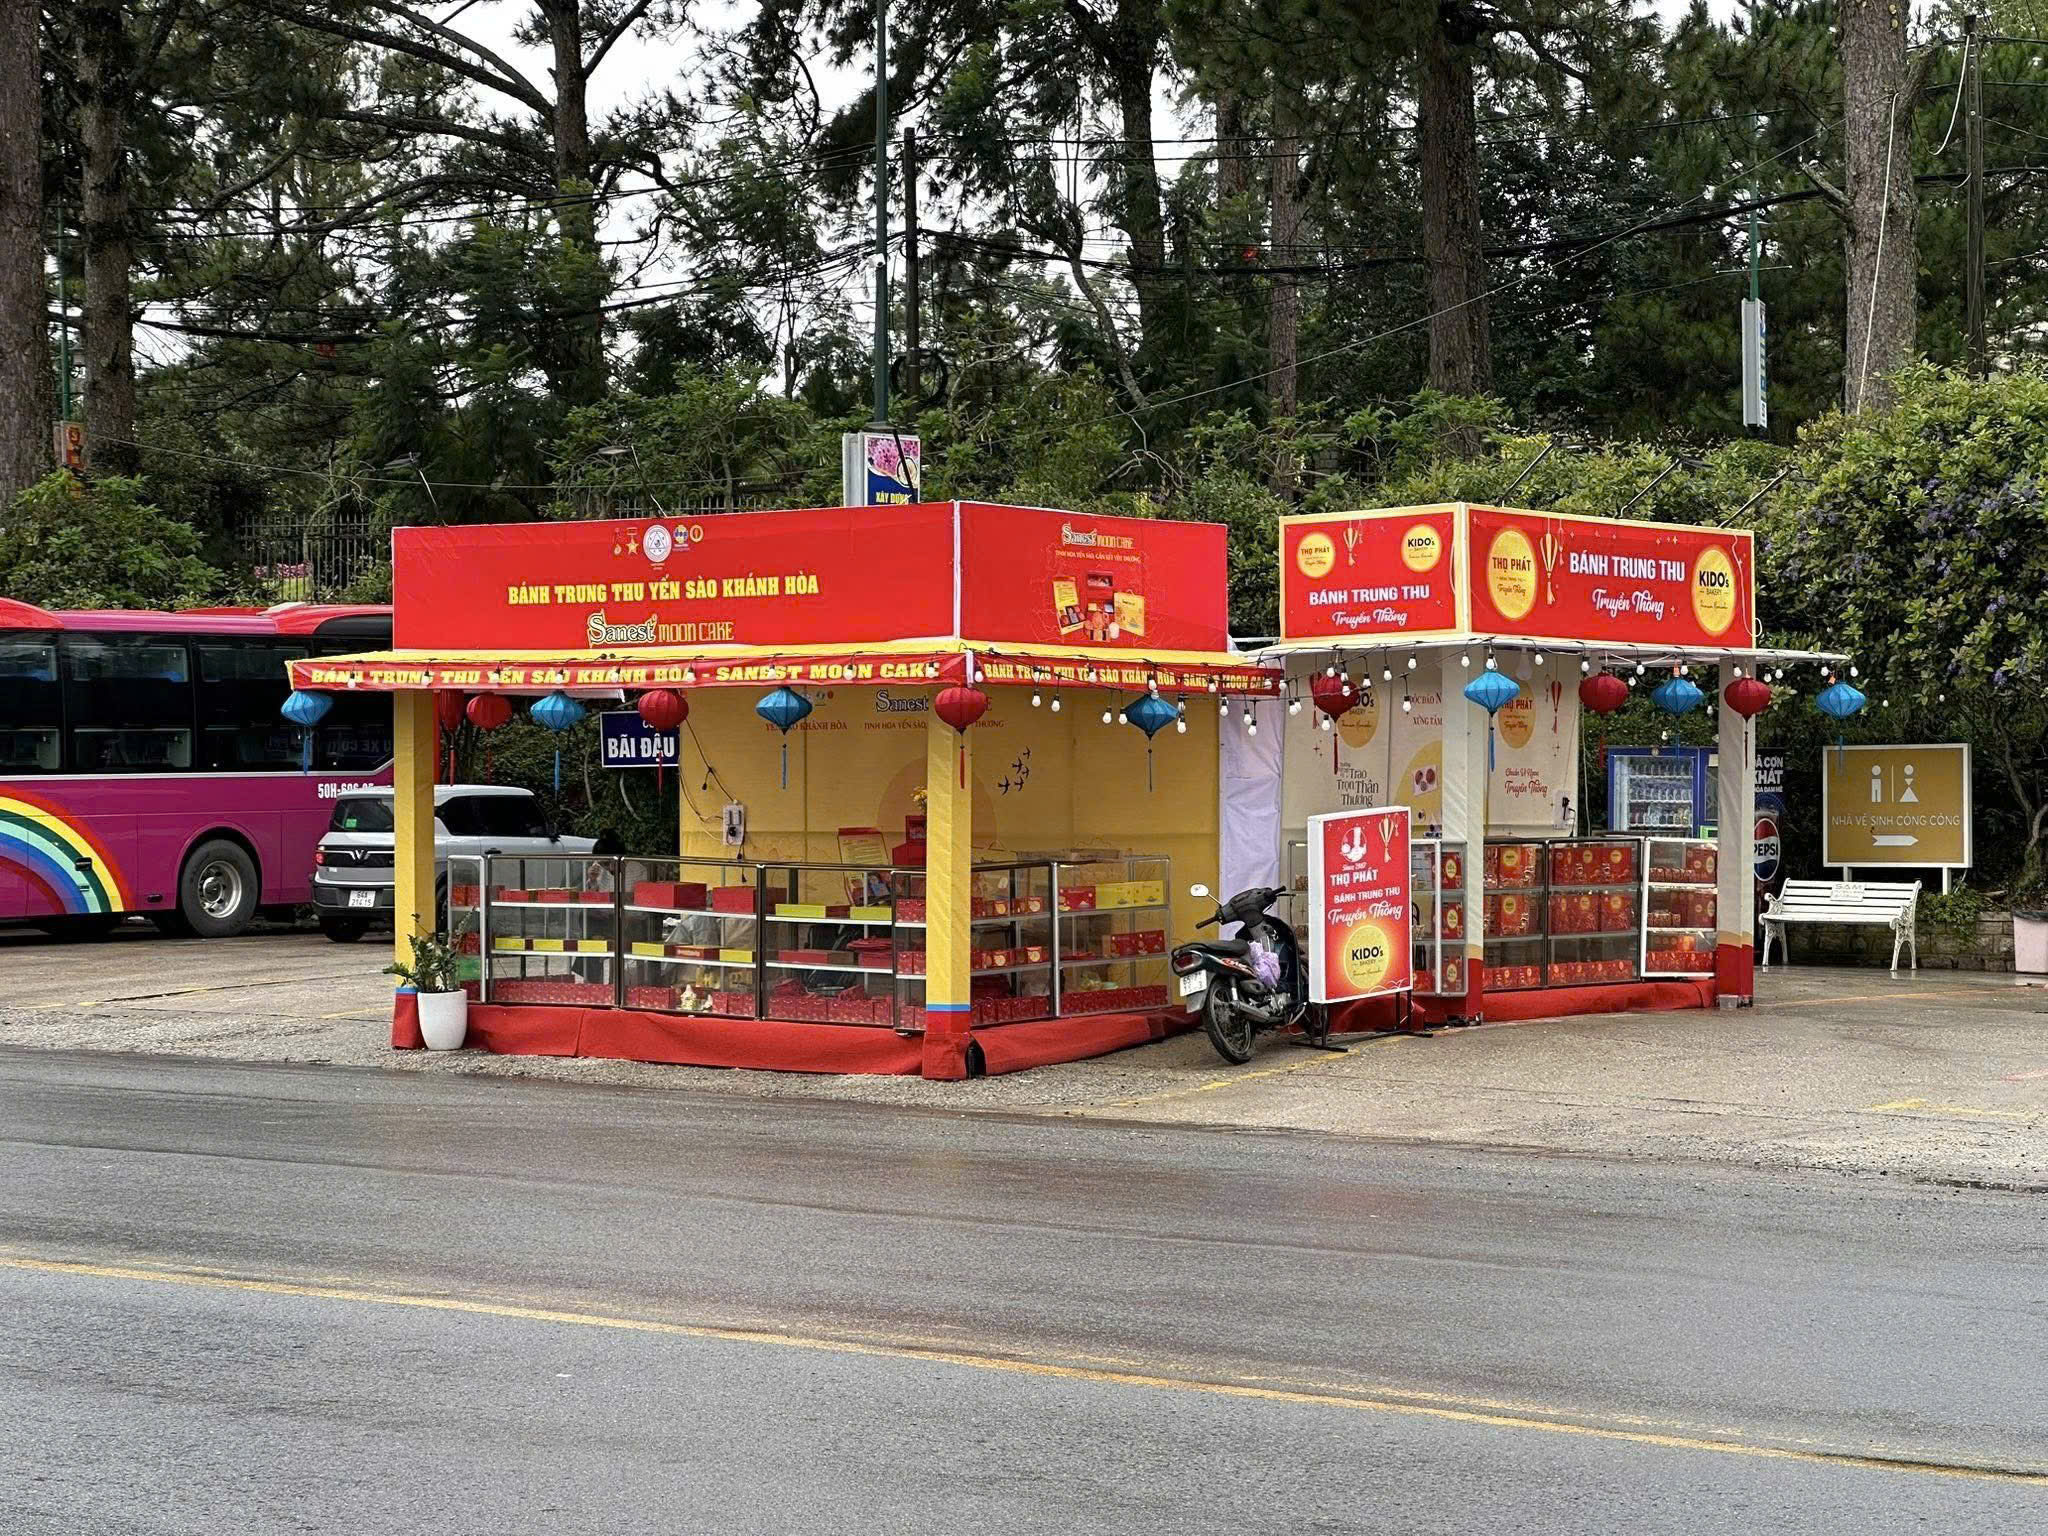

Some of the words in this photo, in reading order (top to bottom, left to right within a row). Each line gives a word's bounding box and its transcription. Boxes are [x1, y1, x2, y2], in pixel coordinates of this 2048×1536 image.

[1492, 556, 1508, 573] THỌ
[1511, 555, 1531, 571] PHÁT
[1569, 550, 1608, 577] BÁNH
[1612, 556, 1656, 579] TRUNG
[1659, 560, 1686, 583] THU
[508, 581, 550, 605] BÁNH
[555, 584, 607, 604] TRUNG
[611, 582, 645, 602] THU
[649, 575, 681, 601] YẾN
[685, 575, 718, 599] SÀO
[722, 572, 779, 598] KHÁNH
[785, 570, 819, 596] HÒA
[1699, 570, 1730, 588] KIDO's
[1309, 588, 1348, 606] BÁNH
[1351, 586, 1399, 604] TRUNG
[1401, 584, 1430, 600] THU
[1592, 588, 1630, 618] Truyền
[1632, 589, 1665, 621] Thống
[588, 609, 657, 648] Sanest
[658, 623, 697, 643] MOON
[699, 622, 735, 642] CAKE
[311, 667, 364, 684] BÁNH
[440, 670, 481, 684] THU
[984, 659, 1015, 680] BÁNH
[1016, 663, 1052, 681] TRNG
[1077, 662, 1097, 682] YẾ
[1099, 665, 1119, 683] SÀO
[1183, 672, 1221, 688] SANET
[876, 688, 929, 714] Sanest
[830, 719, 848, 731] HÒA
[607, 733, 636, 758] BÃI
[641, 732, 675, 762] ĐẬU
[1870, 815, 1894, 826] SINH
[1329, 873, 1350, 888] THỌ
[1352, 867, 1379, 884] PHÁT
[1333, 892, 1356, 905] BÁNH
[1358, 888, 1383, 901] TRUNG
[1384, 886, 1401, 897] THU
[1351, 945, 1384, 961] KIDO's
